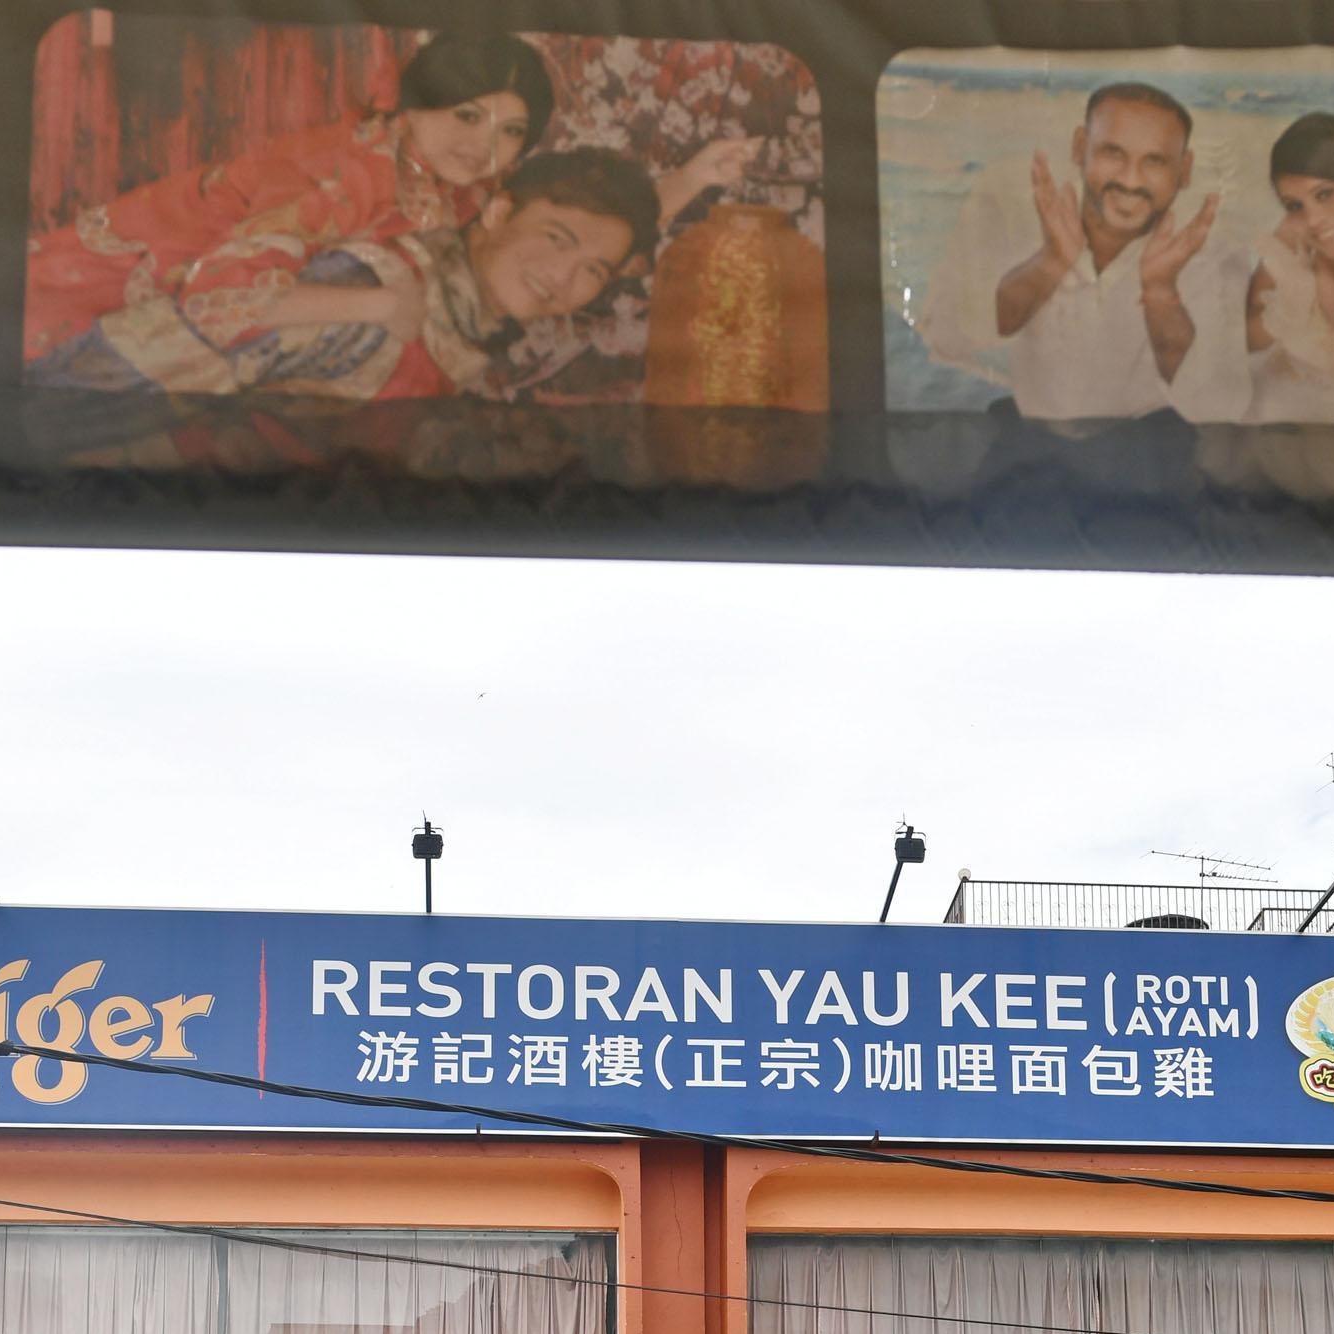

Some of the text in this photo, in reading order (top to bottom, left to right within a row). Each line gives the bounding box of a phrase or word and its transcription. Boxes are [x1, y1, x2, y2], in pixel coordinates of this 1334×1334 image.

[312, 959, 1088, 1031] RESTORAN YAU KEE
